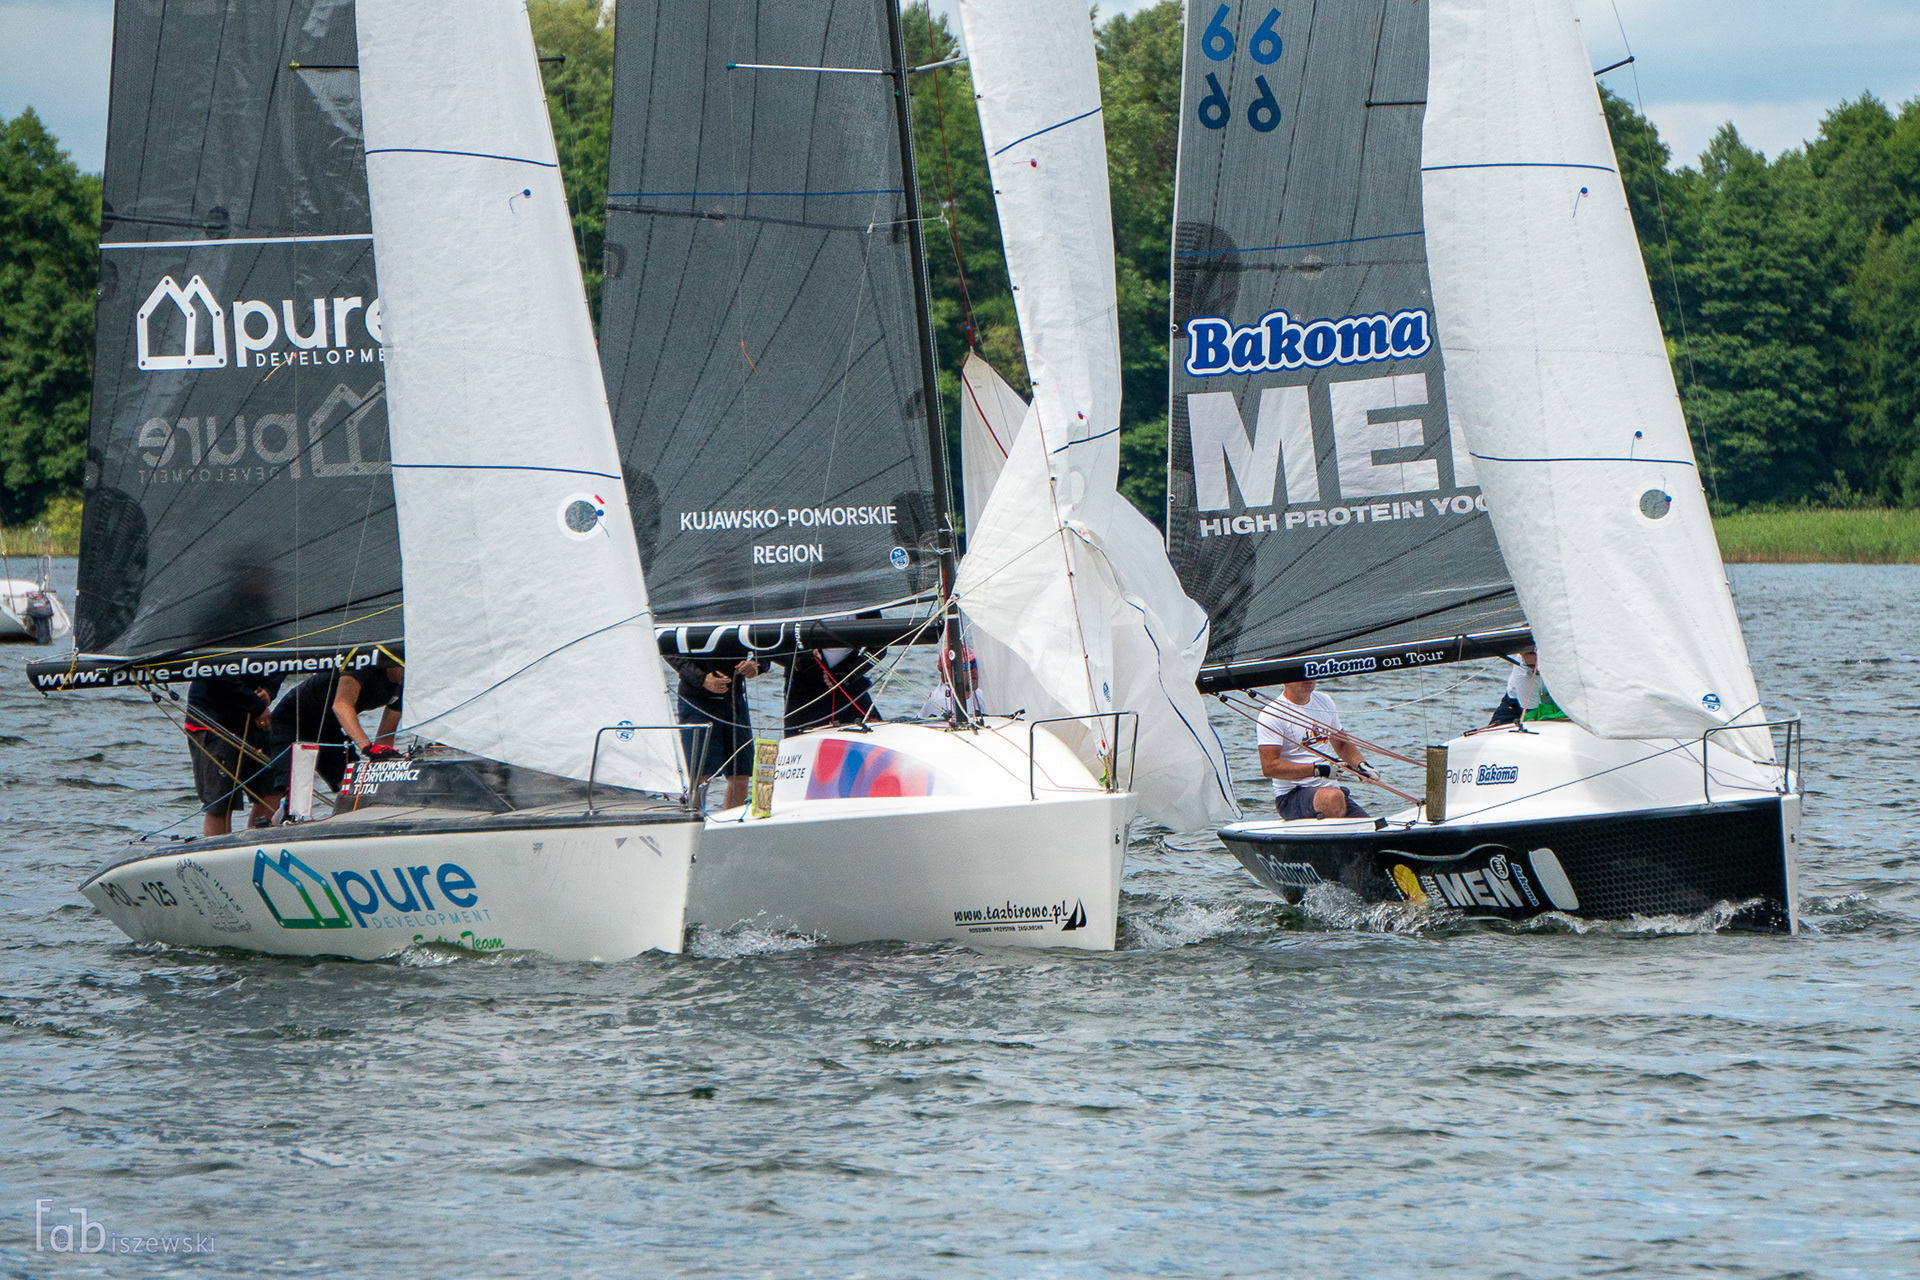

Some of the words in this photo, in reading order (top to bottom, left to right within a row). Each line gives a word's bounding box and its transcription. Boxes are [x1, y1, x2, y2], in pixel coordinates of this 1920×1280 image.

[1201, 3, 1283, 65] 66
[1185, 308, 1433, 377] Bakoma
[680, 505, 898, 531] KUJAWSKO-POMORSKIE
[1200, 512, 1278, 537] HIGH
[1284, 500, 1425, 530] PROTEIN
[753, 544, 823, 564] REGION
[1304, 656, 1377, 678] Bakoma
[1382, 656, 1403, 668] on
[1405, 650, 1444, 665] Tour
[777, 754, 802, 766] UJAWY
[774, 767, 806, 780] OMORZE
[1447, 769, 1460, 784] Pol
[1462, 768, 1474, 783] 66
[1476, 764, 1519, 785] Bakoma
[353, 783, 379, 795] TUTAJ
[98, 881, 178, 907] POL-125
[331, 863, 479, 928] pure
[1435, 867, 1524, 908] MEN
[371, 909, 492, 929] DEVELOPMENT
[954, 900, 1068, 925] www.tazbirowo.pl
[460, 930, 505, 951] Team
